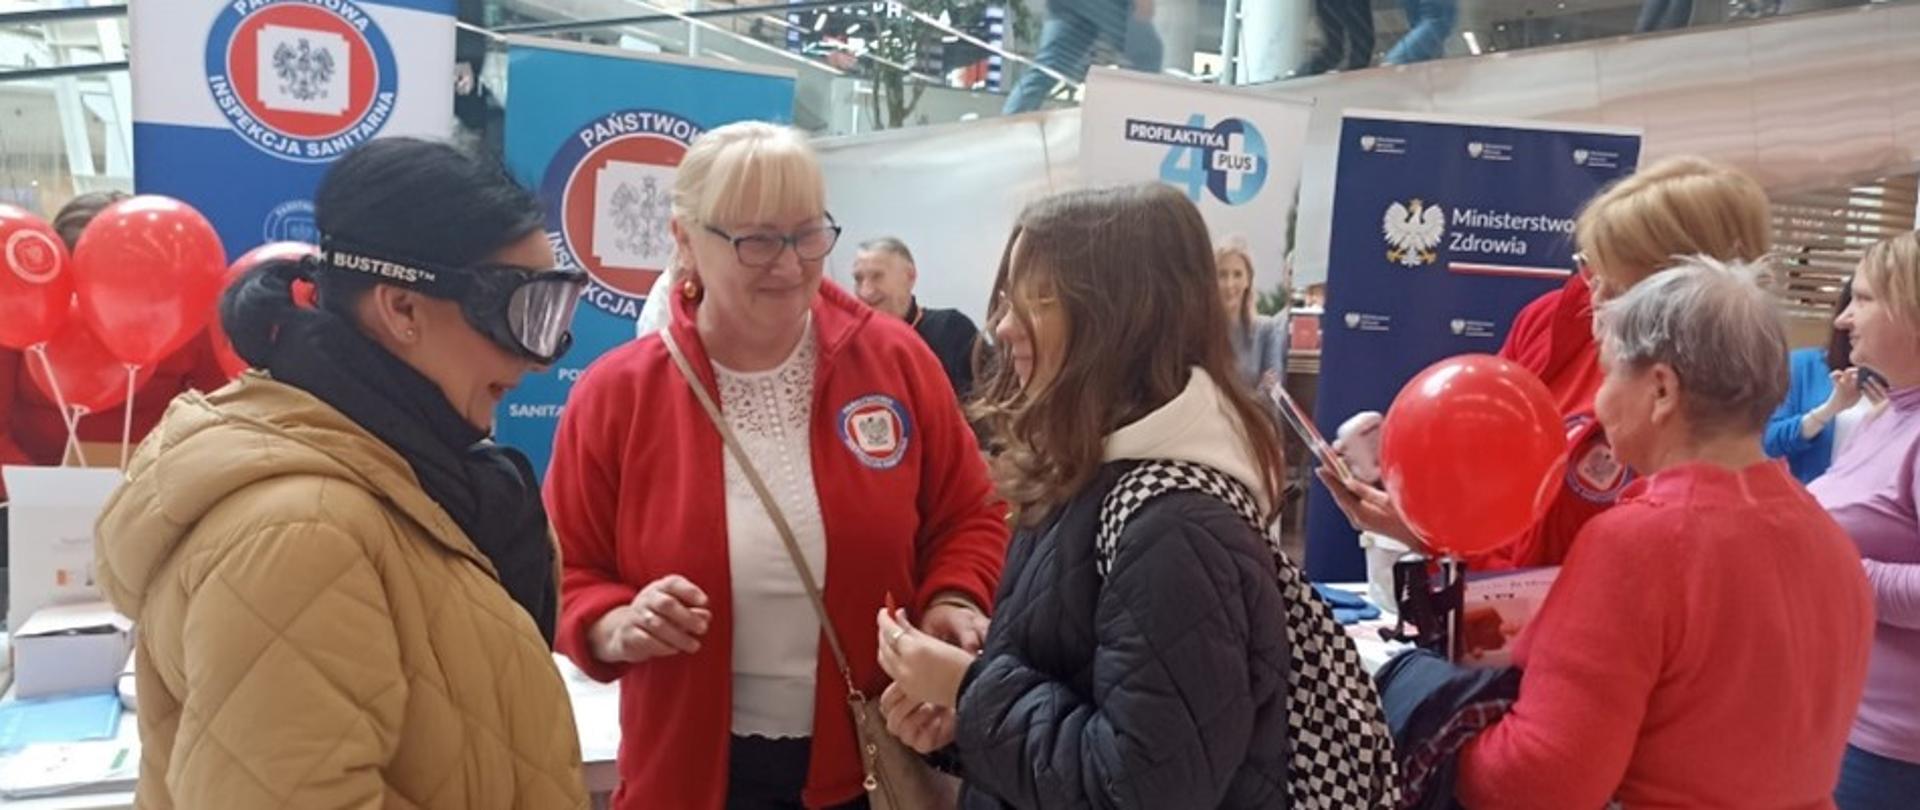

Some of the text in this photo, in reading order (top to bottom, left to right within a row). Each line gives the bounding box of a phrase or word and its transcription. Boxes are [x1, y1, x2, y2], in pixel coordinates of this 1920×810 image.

[209, 75, 394, 157] INSPEKCJA SANITARNA
[1129, 123, 1225, 147] PROFILAKTYKA
[1217, 153, 1252, 170] PLUS
[1452, 208, 1576, 233] Ministerstwo
[1449, 232, 1527, 255] Zdrowia
